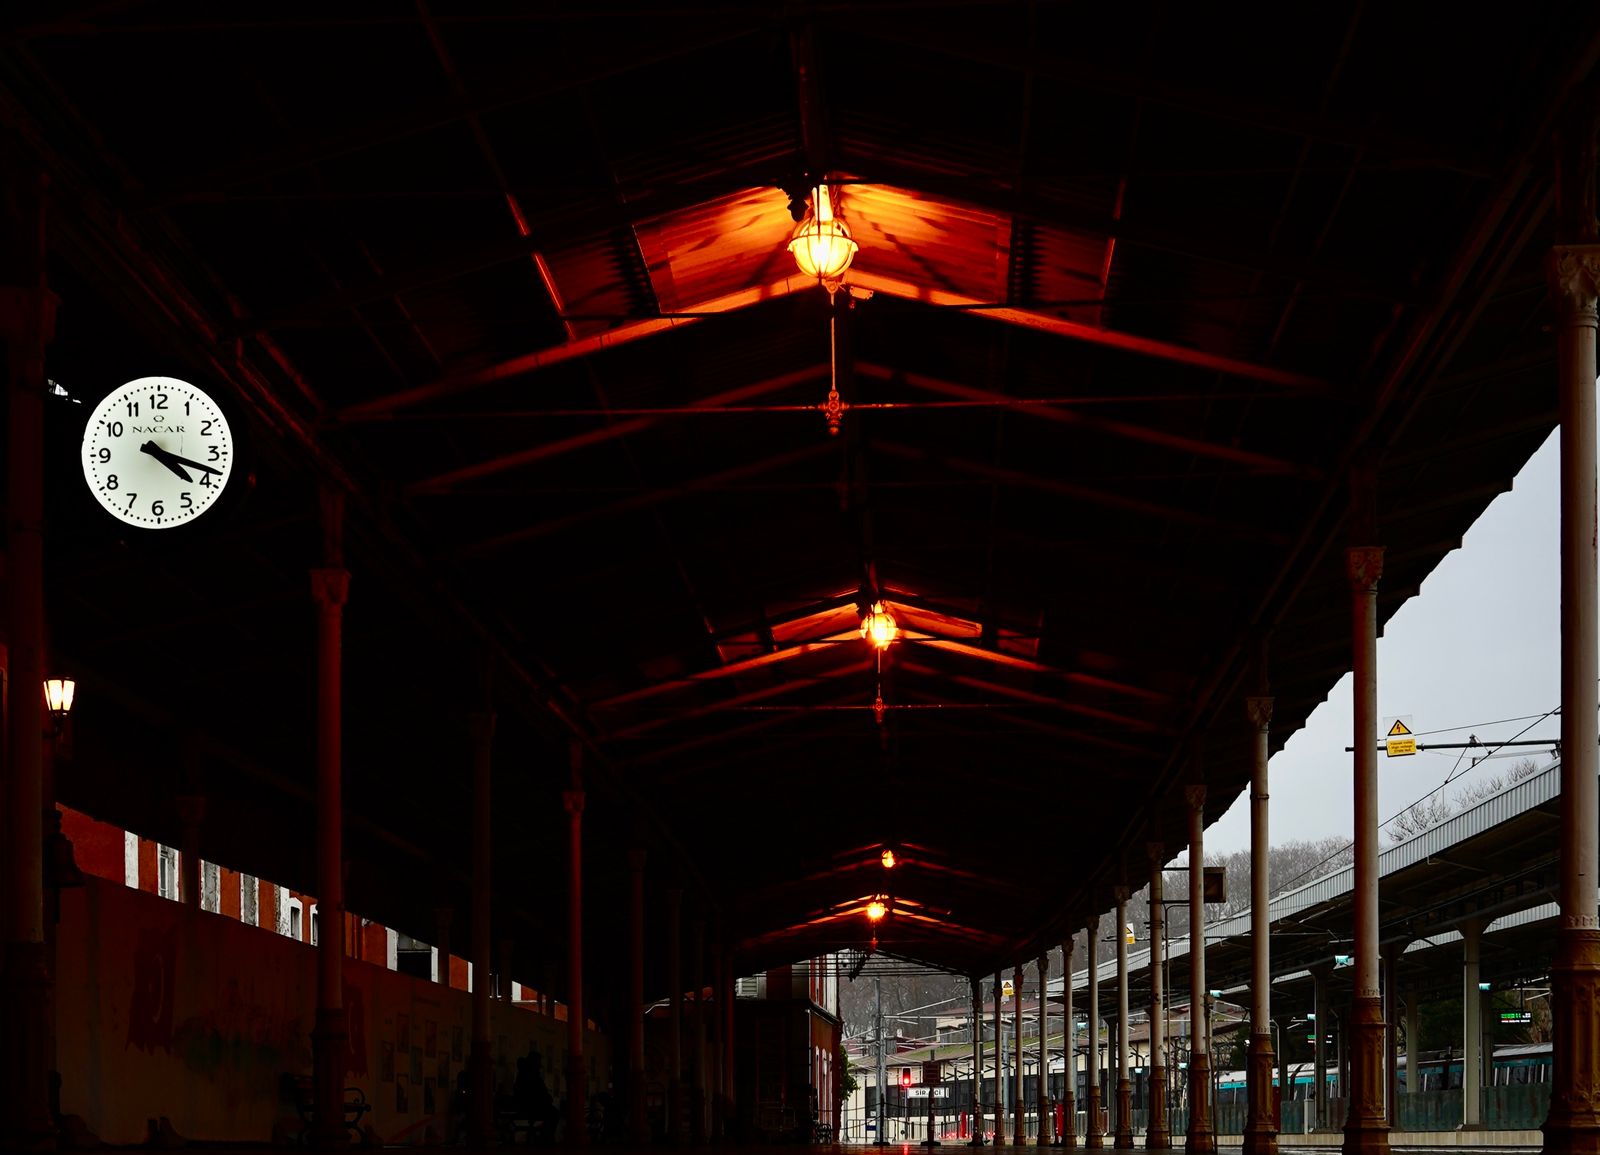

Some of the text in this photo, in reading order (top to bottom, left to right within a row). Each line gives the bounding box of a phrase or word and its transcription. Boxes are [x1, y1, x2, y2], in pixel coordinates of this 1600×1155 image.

[126, 402, 139, 417] 11
[149, 394, 169, 410] 12
[184, 401, 190, 416] 1
[106, 421, 124, 437] 10
[132, 425, 186, 433] NACAR
[200, 420, 213, 436] 2
[98, 448, 112, 463] 9
[207, 446, 220, 461] 3
[106, 474, 119, 490] 8
[199, 472, 212, 488] 4
[126, 493, 138, 508] 7
[151, 500, 165, 516] 6
[180, 492, 193, 508] 5
